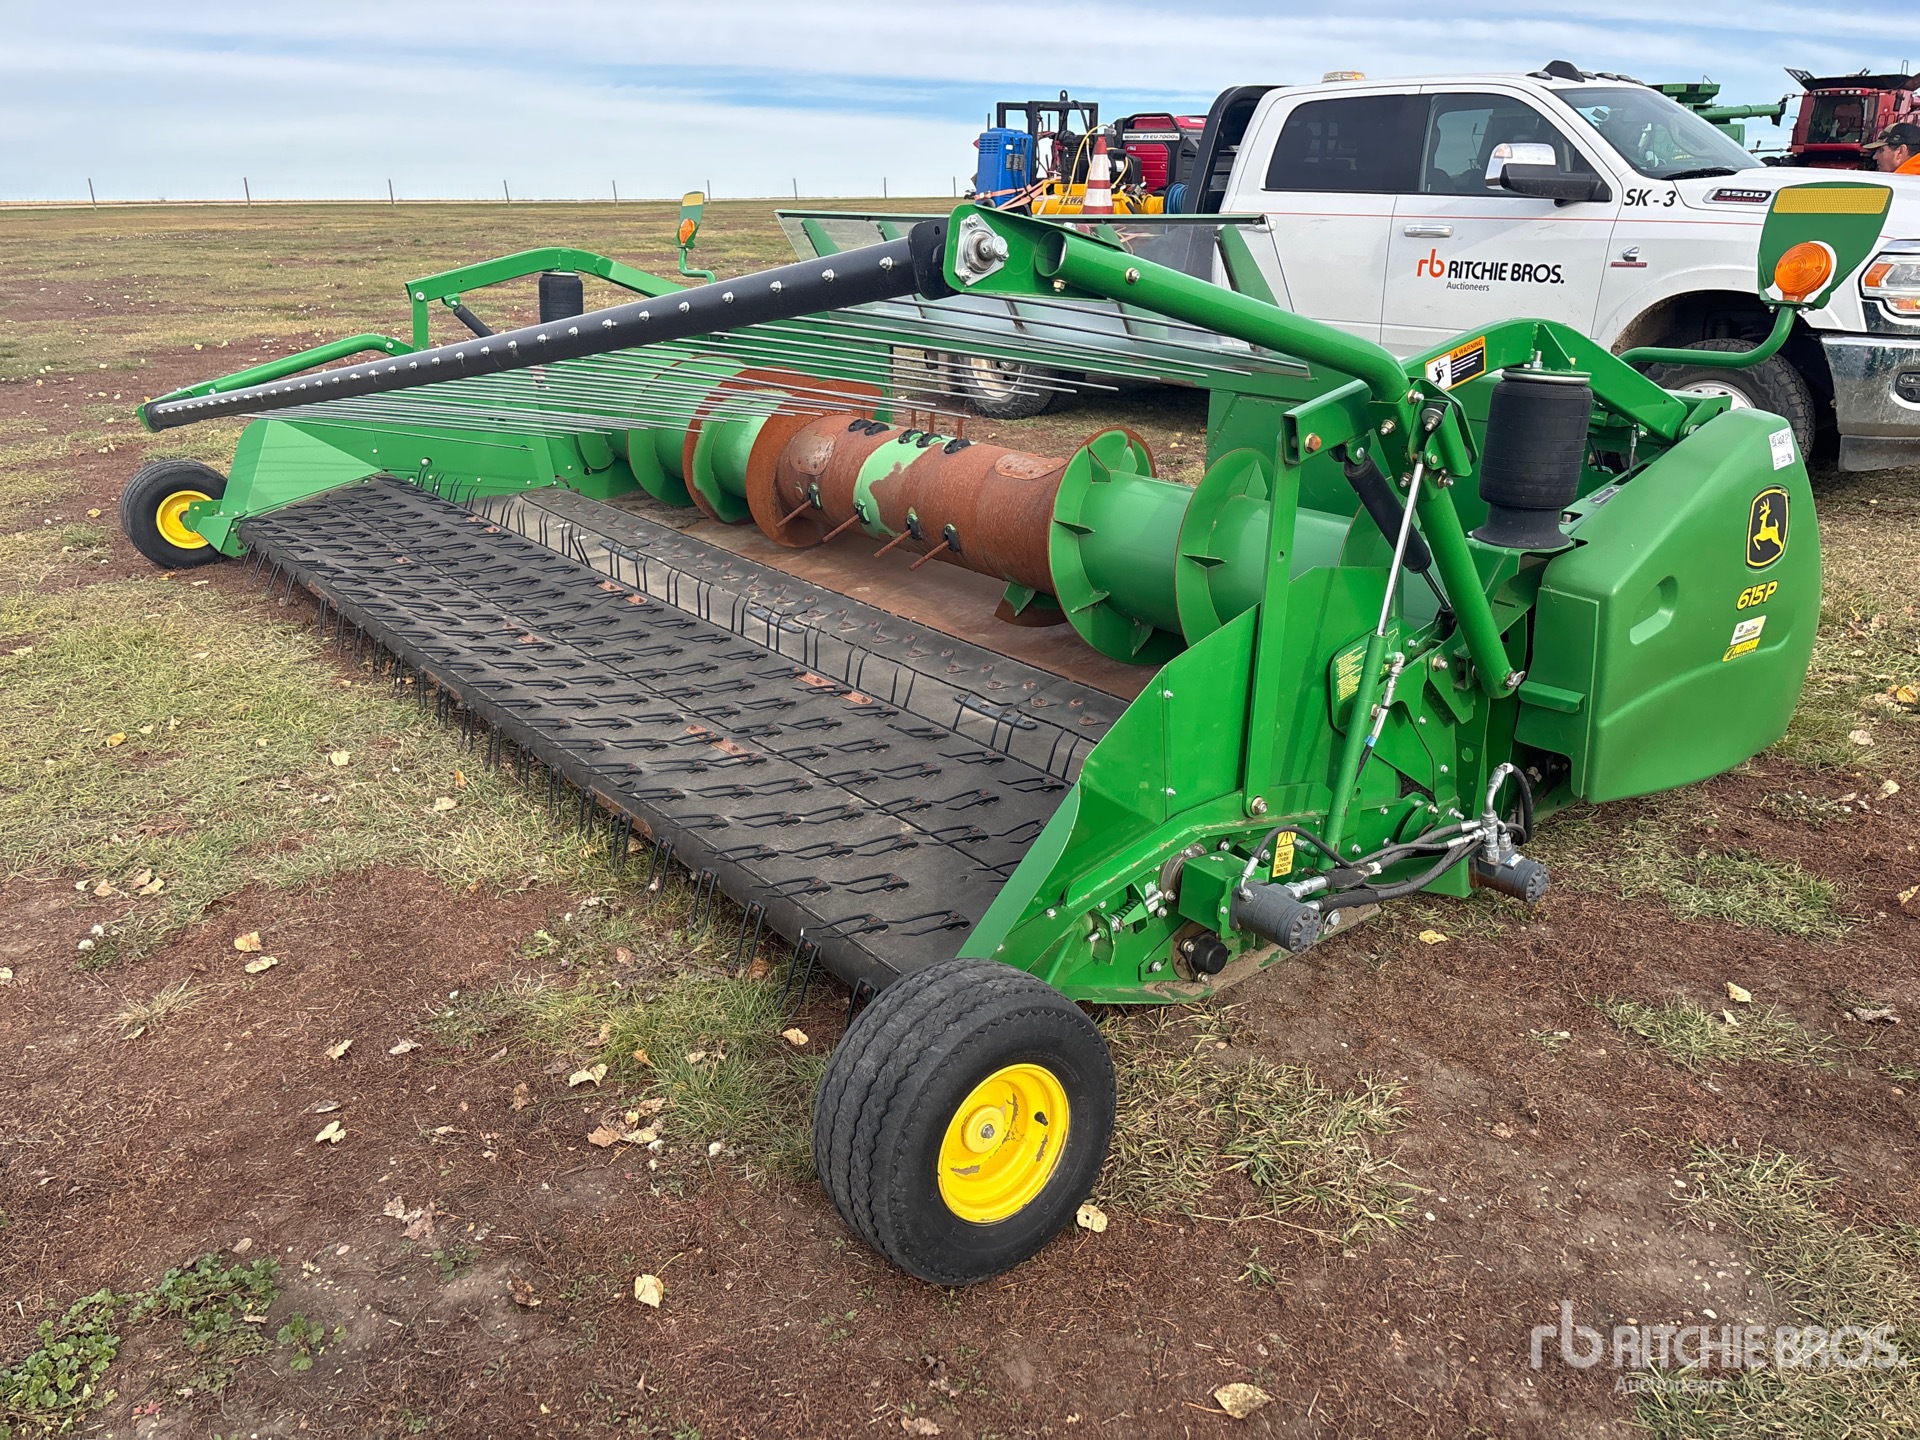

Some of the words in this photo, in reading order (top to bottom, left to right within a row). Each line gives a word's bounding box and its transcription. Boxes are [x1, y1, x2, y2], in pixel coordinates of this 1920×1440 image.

[1719, 190, 1767, 198] 3500
[1416, 248, 1445, 278] rb
[1447, 260, 1508, 281] RITCHIE
[1510, 263, 1565, 284] BROS.
[1446, 281, 1490, 292] Auctioneers
[1458, 339, 1483, 355] WARNING
[1736, 580, 1778, 610] 615P
